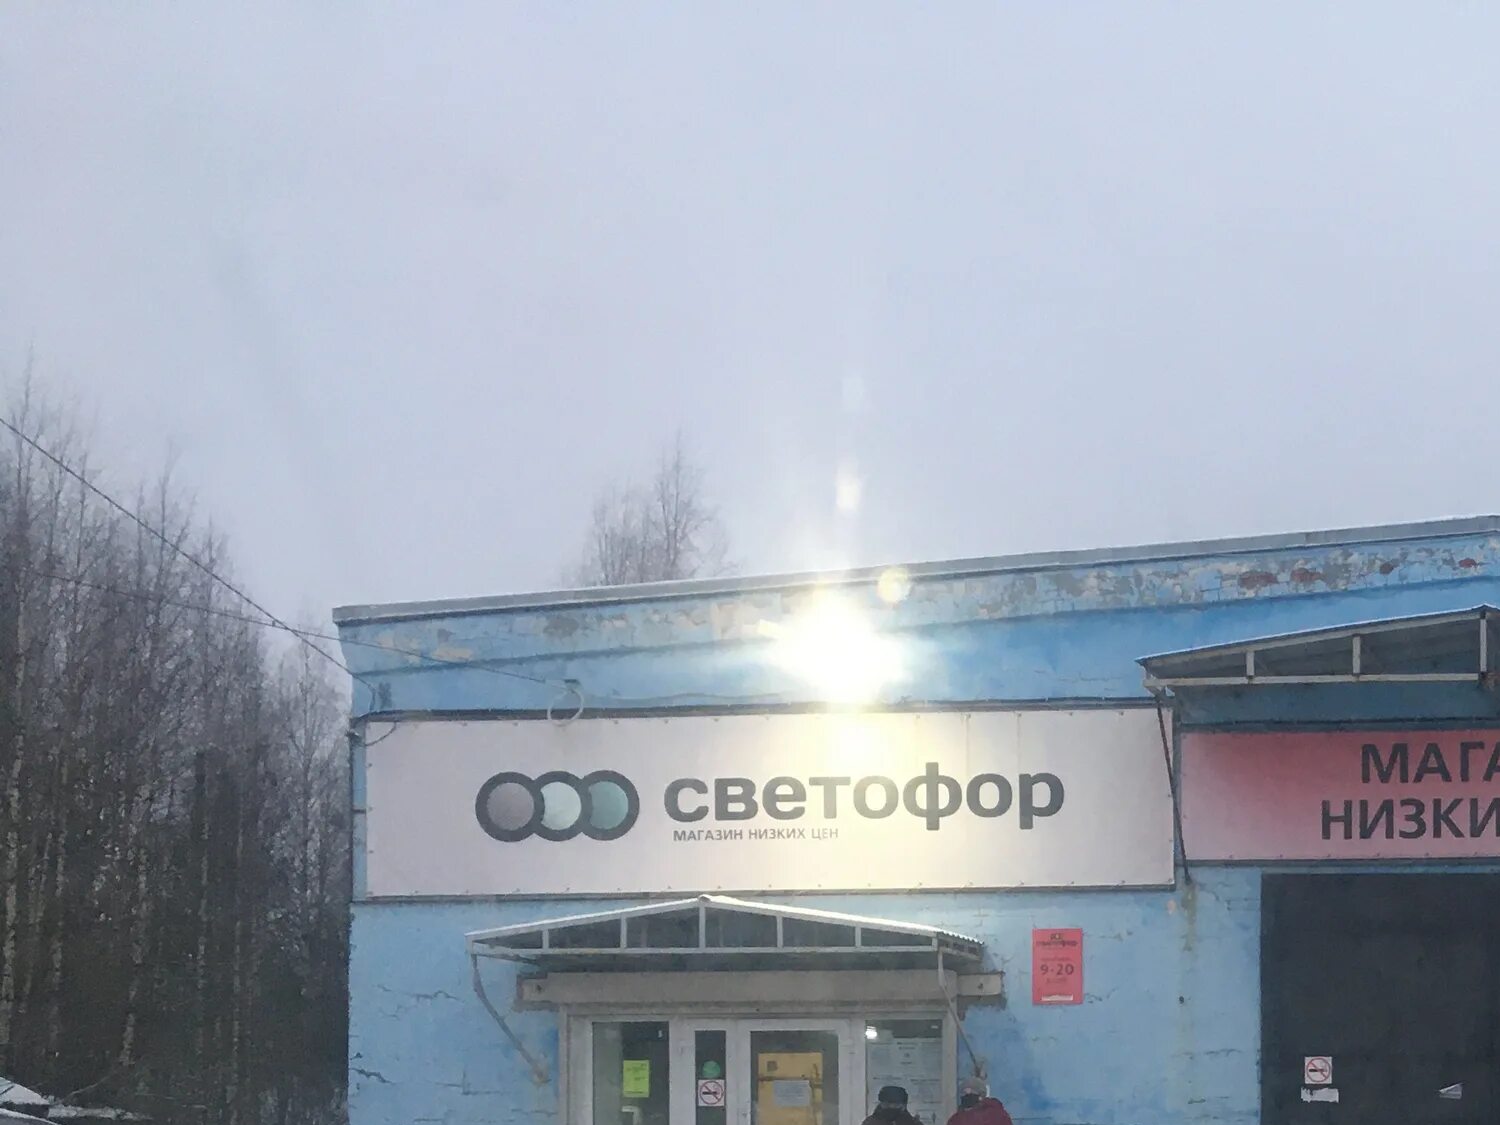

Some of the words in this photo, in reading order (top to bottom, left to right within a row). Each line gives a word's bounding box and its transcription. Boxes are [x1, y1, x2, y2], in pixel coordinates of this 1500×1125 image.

[664, 762, 1066, 830] светофор
[673, 829, 743, 842] МАГАЗИН
[748, 828, 806, 840] НИЗКИХ
[811, 828, 839, 840] ЦЕН
